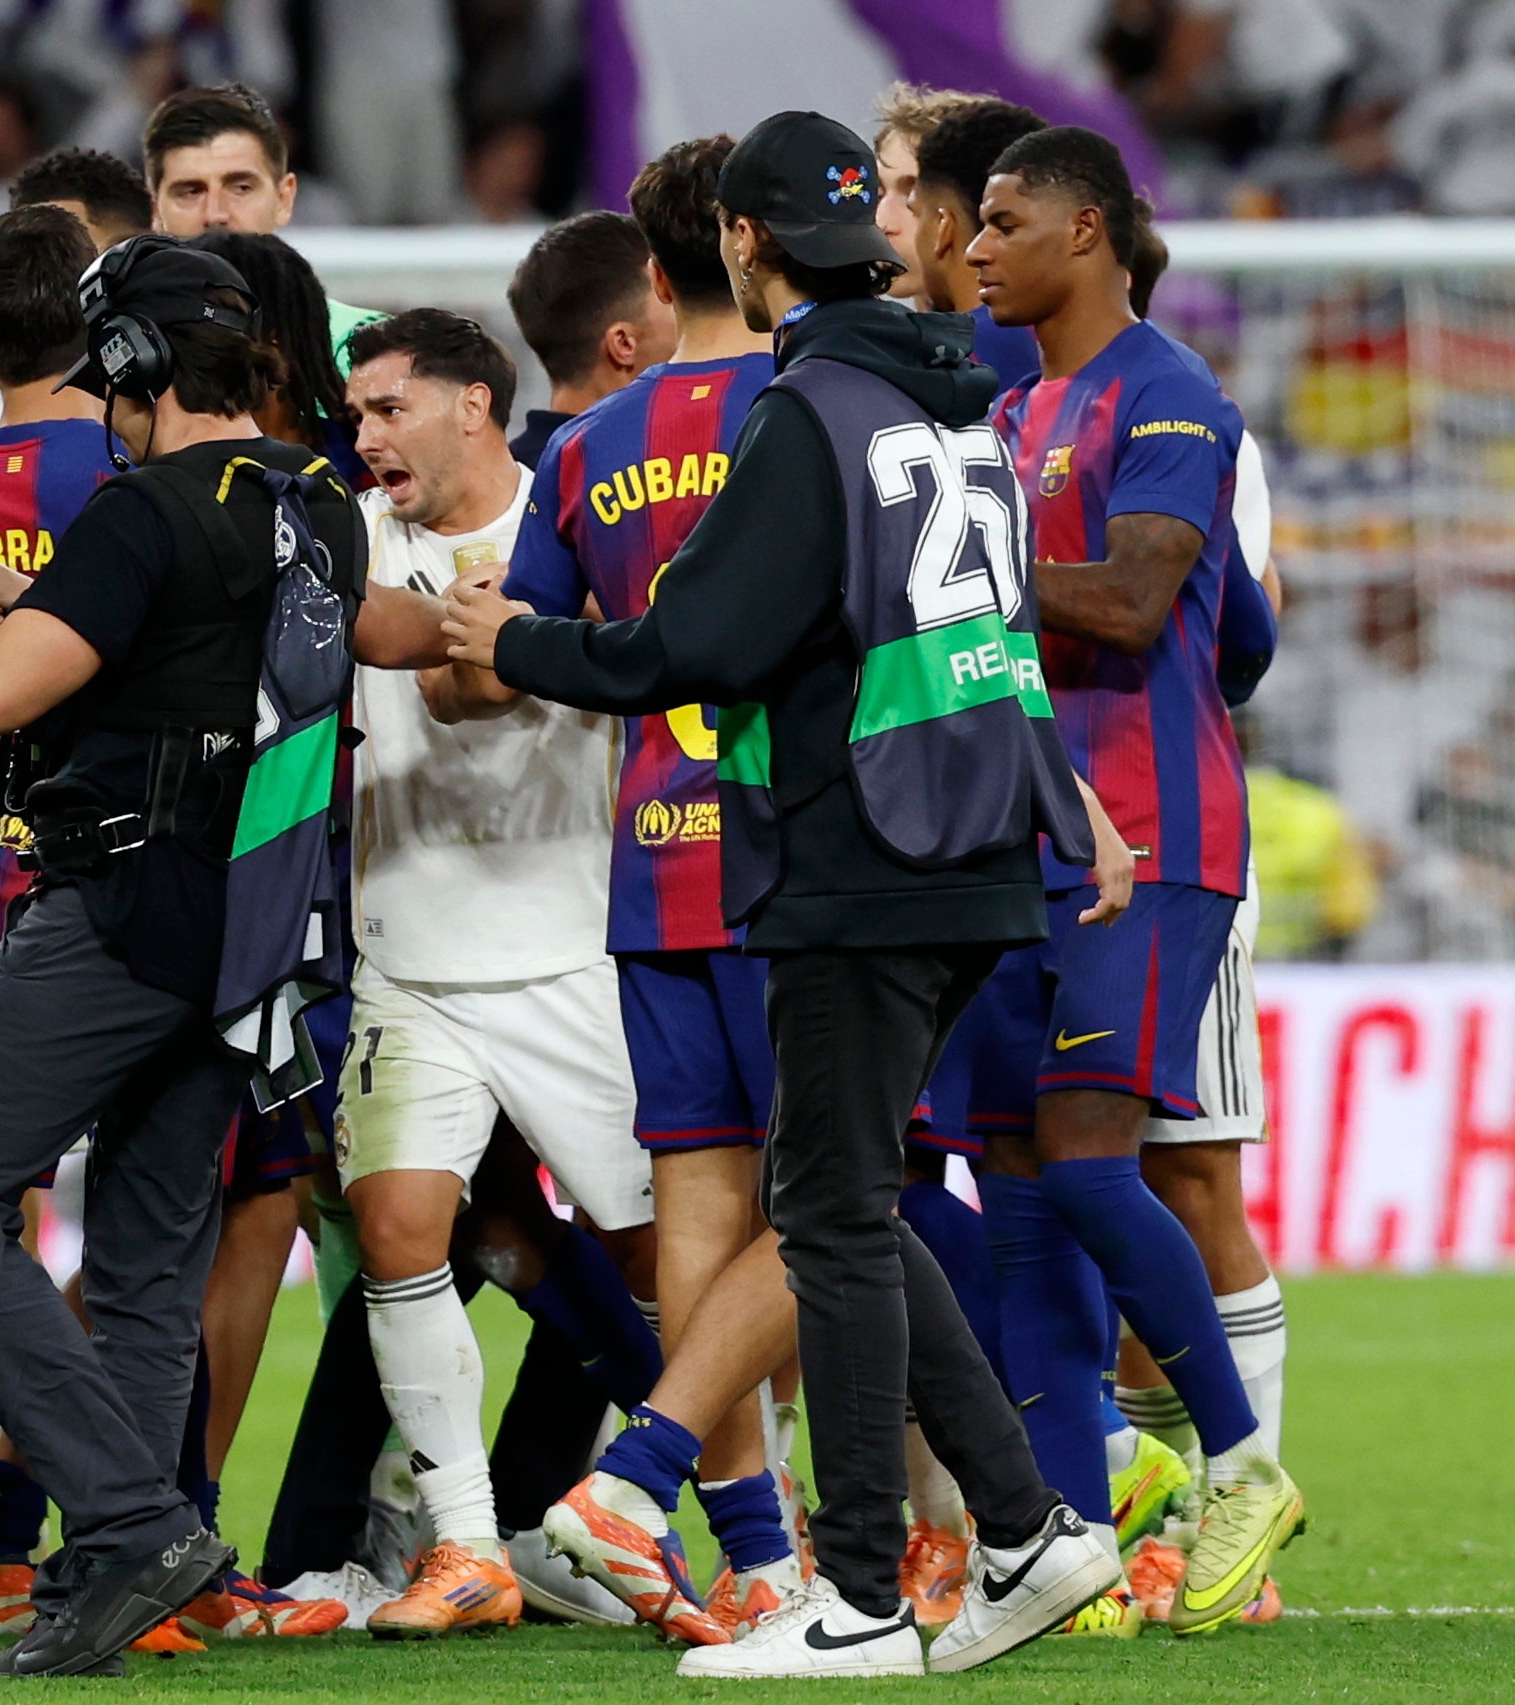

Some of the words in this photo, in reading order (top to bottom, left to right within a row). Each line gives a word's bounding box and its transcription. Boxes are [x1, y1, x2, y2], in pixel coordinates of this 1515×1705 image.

[99, 332, 123, 359] RTS
[1130, 420, 1206, 439] AMBILIGHT
[590, 452, 730, 525] CUBAR
[679, 815, 721, 834] ACN
